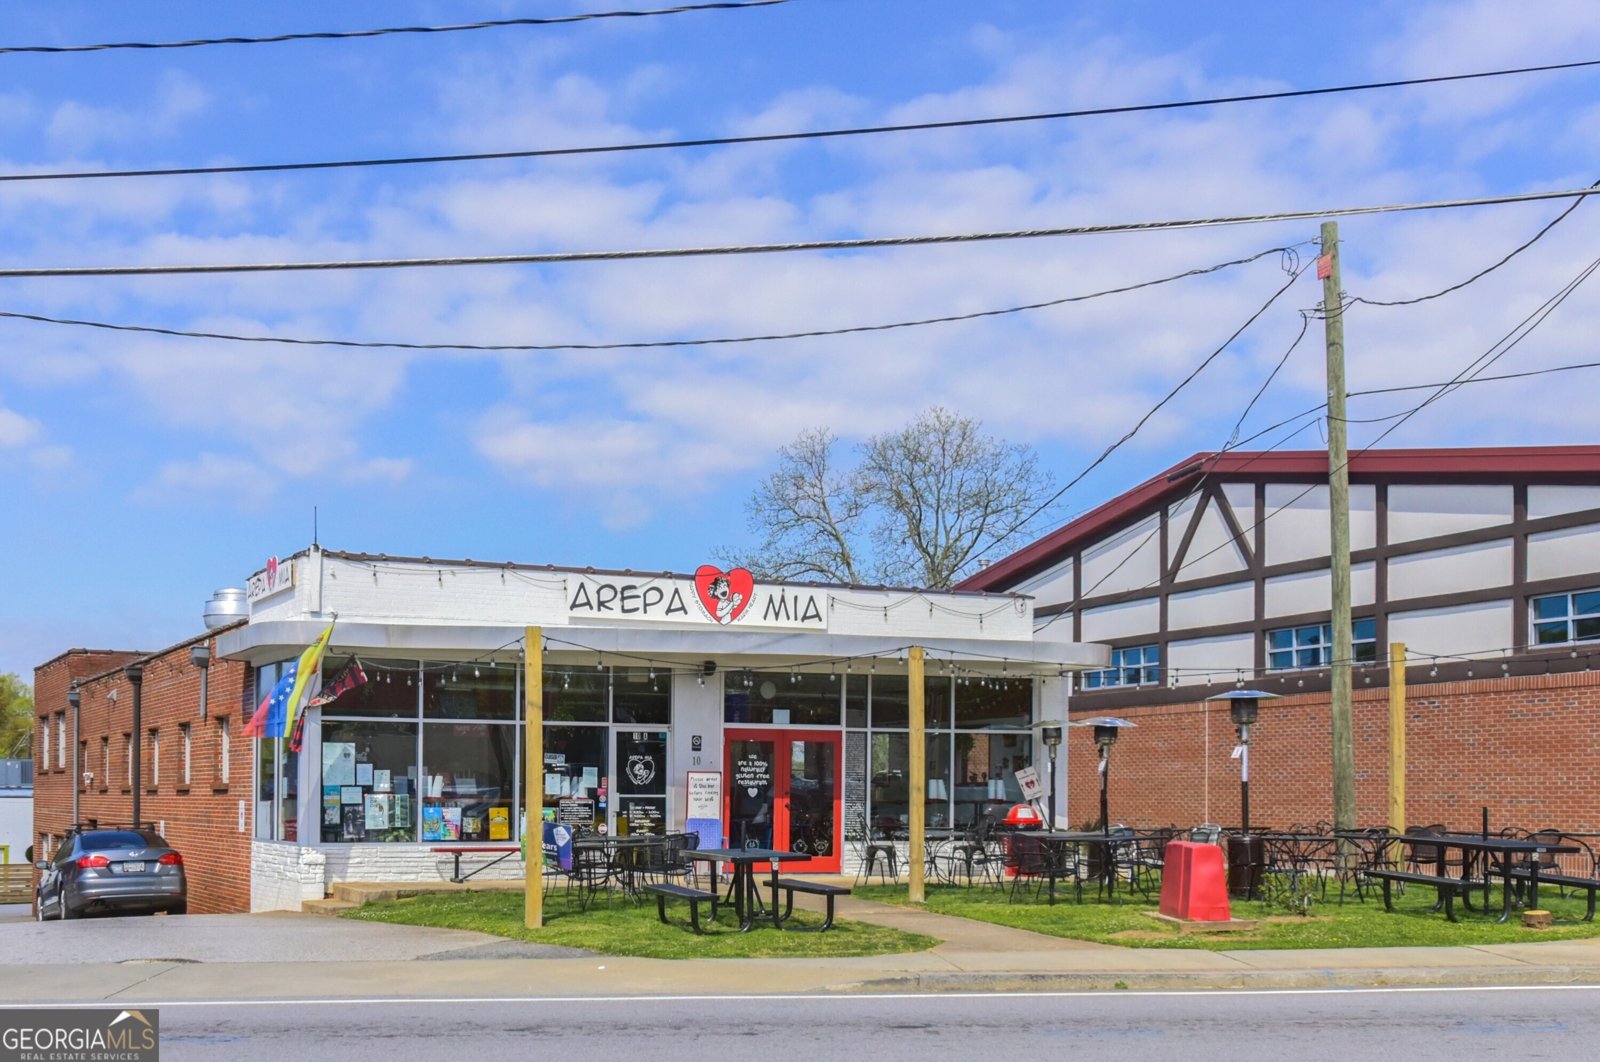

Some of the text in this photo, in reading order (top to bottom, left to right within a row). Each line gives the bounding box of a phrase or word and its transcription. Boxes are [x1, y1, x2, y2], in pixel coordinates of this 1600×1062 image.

[569, 582, 822, 622] AREPA MIA
[692, 756, 701, 766] 10
